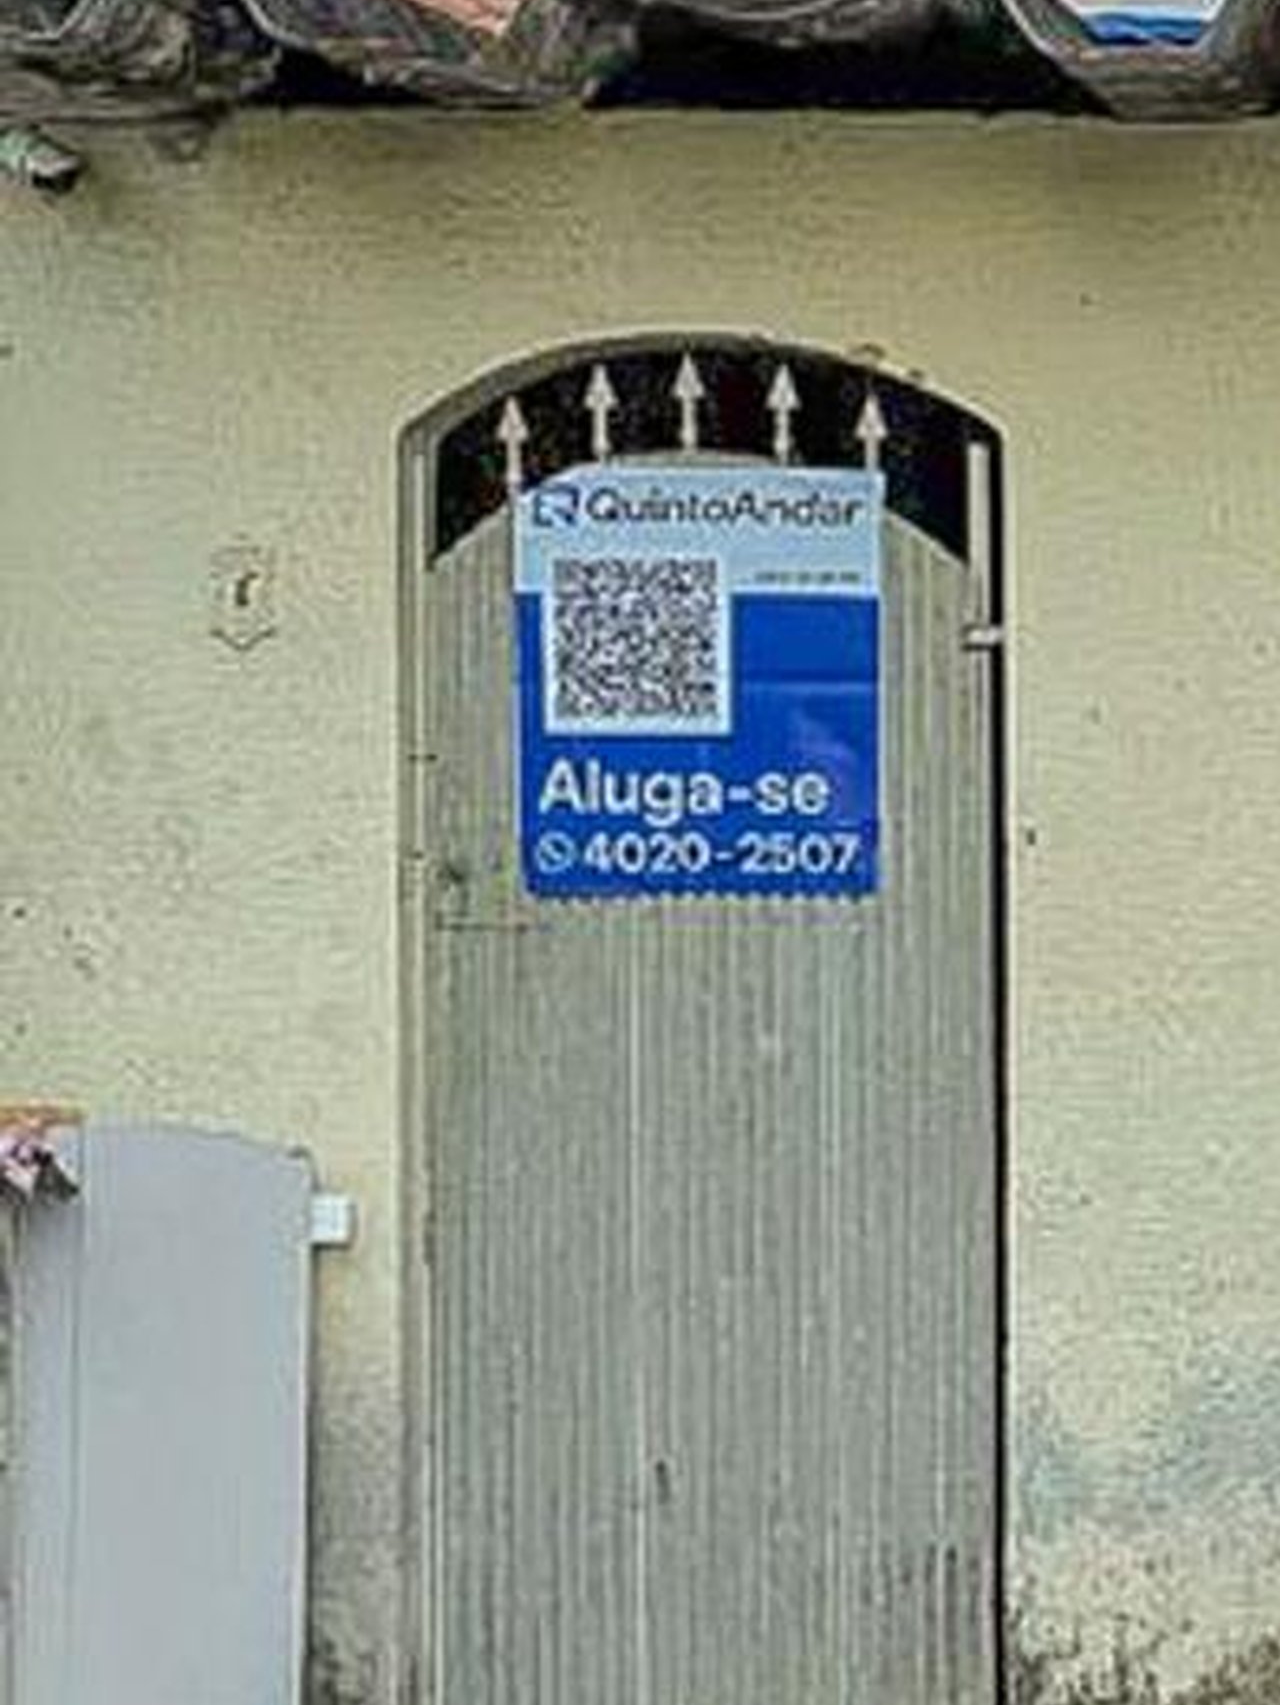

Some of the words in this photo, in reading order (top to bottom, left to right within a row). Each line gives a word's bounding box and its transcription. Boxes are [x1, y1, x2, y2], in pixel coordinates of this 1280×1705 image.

[585, 486, 863, 527] QuintoAndar
[538, 758, 831, 828] Aluga-se
[582, 832, 862, 874] 4020-2507
